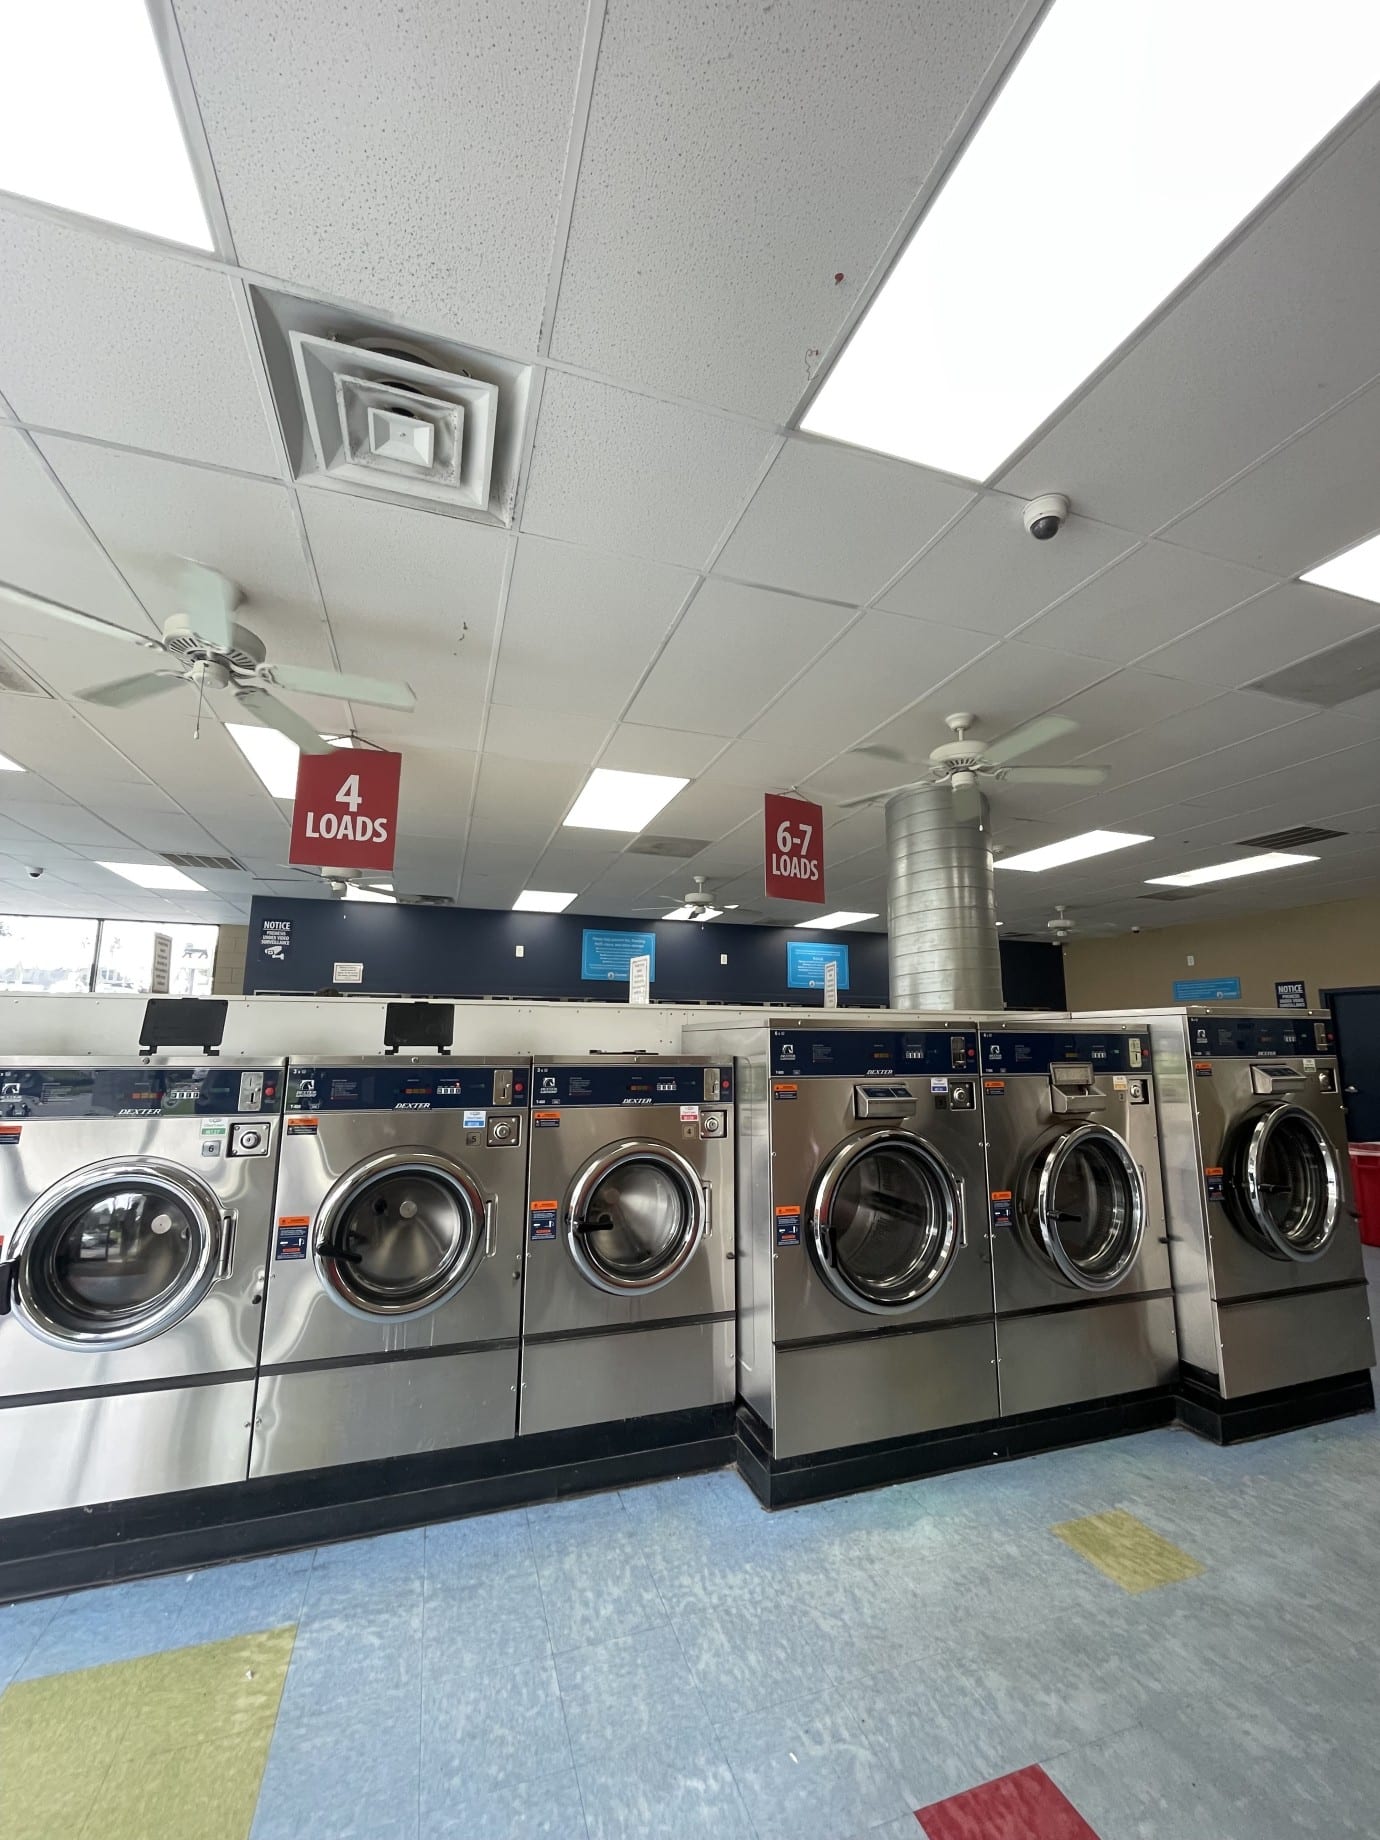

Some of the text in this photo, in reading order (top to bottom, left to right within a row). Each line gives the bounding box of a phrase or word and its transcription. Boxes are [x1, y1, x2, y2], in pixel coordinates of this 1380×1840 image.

[335, 774, 363, 812] 4
[305, 811, 388, 843] LOADS
[776, 821, 813, 856] 6-7
[772, 853, 819, 881] LOADS
[264, 921, 290, 929] NOTICE
[1278, 984, 1304, 993] NOTICE
[471, 1135, 477, 1143] 5
[208, 1144, 214, 1153] 6
